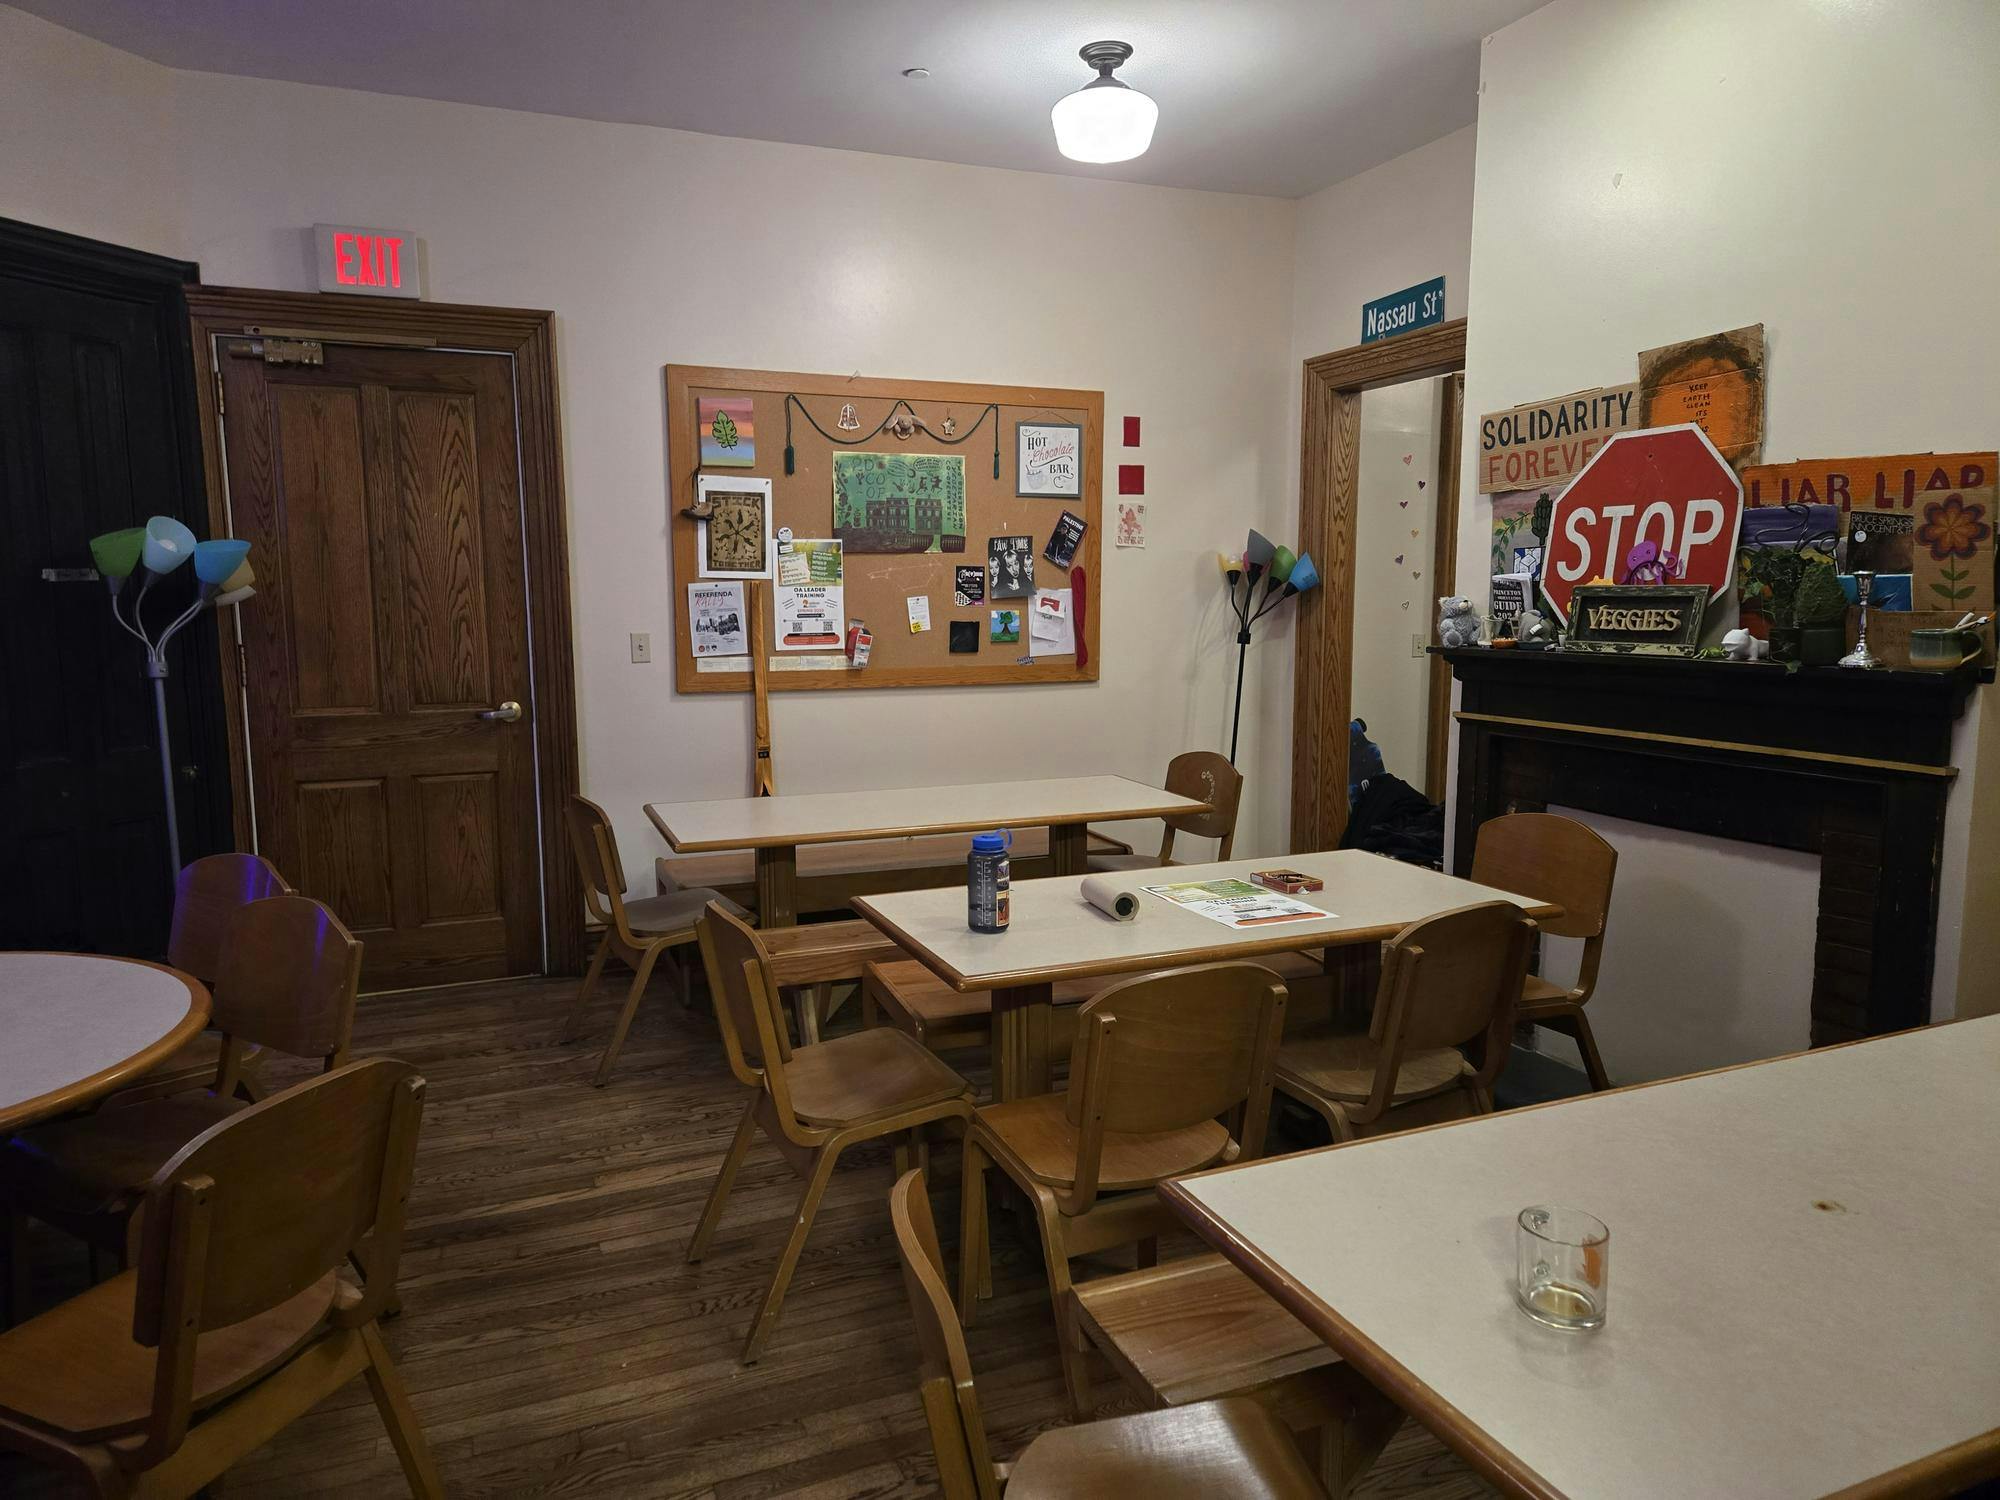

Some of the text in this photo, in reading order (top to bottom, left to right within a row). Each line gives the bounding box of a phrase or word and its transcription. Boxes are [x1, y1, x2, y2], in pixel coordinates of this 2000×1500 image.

[334, 232, 403, 288] EXIT
[1367, 290, 1437, 337] Nassau St
[1689, 383, 1709, 392] KEEP
[1683, 393, 1710, 402] EARTH
[1482, 391, 1633, 450] SOLIDARITY
[1027, 437, 1048, 450] HOT
[1033, 440, 1074, 462] Chocolate
[1488, 435, 1611, 485] FOREVE
[1049, 464, 1070, 474] BAR
[1751, 473, 1851, 513] LIAR
[711, 496, 760, 509] STICK
[1062, 515, 1085, 531] PALESTINE
[1851, 513, 1877, 524] BRUCE
[1556, 499, 1725, 581] STOP
[712, 560, 761, 568] TOGETHER
[1493, 601, 1522, 610] GUIDE
[1588, 605, 1682, 631] VEGGIES
